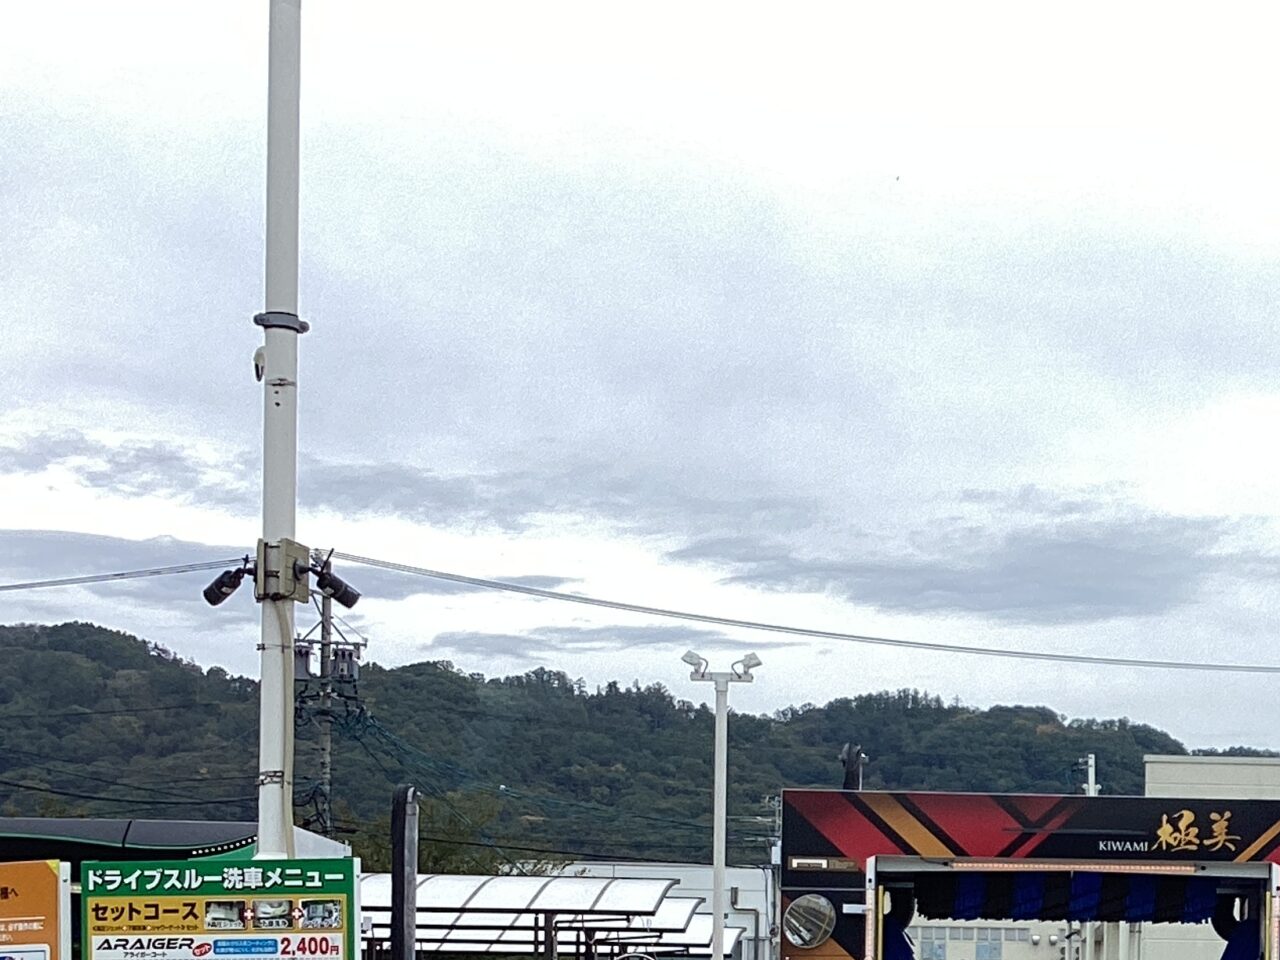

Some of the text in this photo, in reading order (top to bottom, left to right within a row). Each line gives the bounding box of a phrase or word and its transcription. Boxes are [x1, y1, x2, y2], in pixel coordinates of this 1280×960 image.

[1099, 809, 1242, 852] KIWAMI 極美
[87, 866, 345, 891] ドライブスルー洗車メニュー
[92, 902, 200, 922] セットコース
[96, 938, 195, 950] ARAIGER
[193, 944, 212, 955] セット
[280, 937, 339, 956] 2,400円
